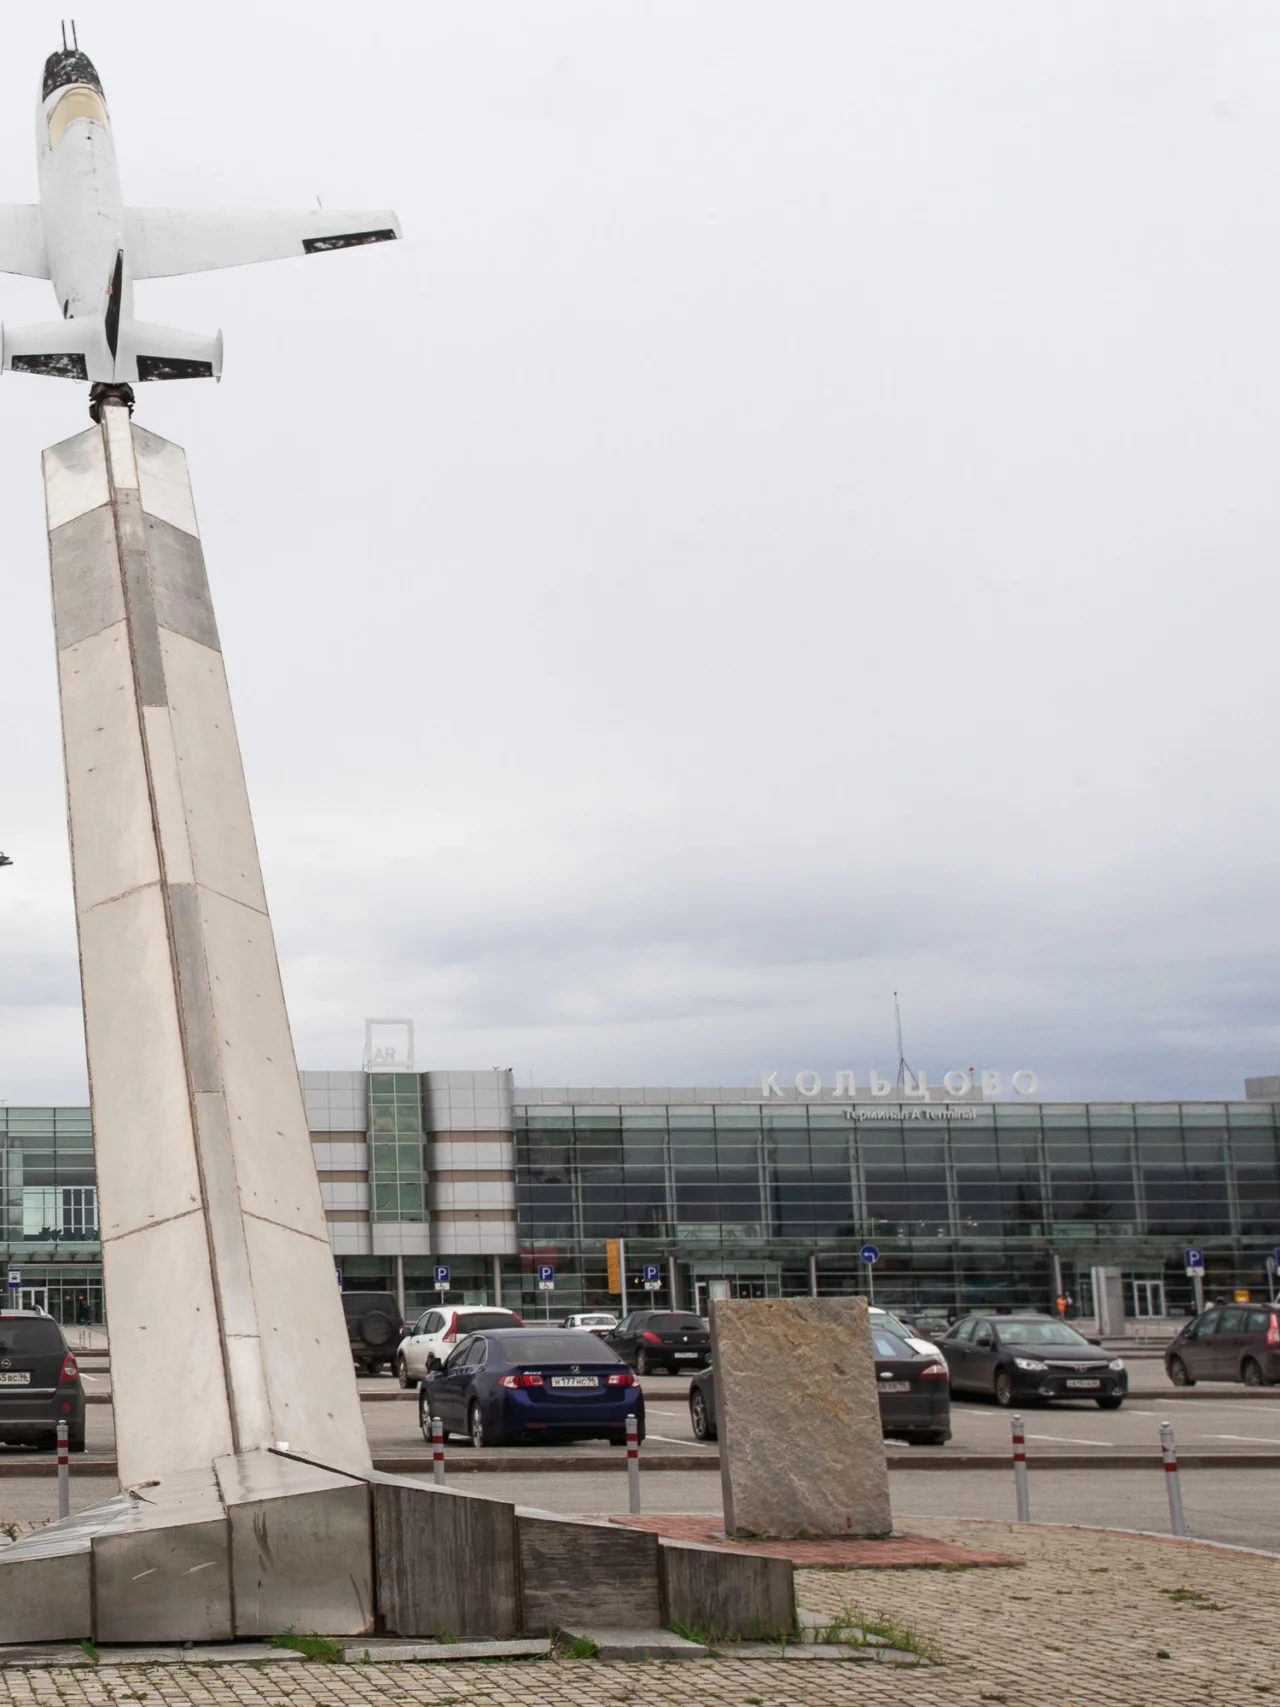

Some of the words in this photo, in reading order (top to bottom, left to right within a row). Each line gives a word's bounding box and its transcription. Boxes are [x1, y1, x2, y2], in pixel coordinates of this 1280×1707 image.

[761, 1070, 1040, 1101] КОЛЬЦОВО
[844, 1109, 908, 1122] Терминал
[923, 1108, 976, 1119] Terminal
